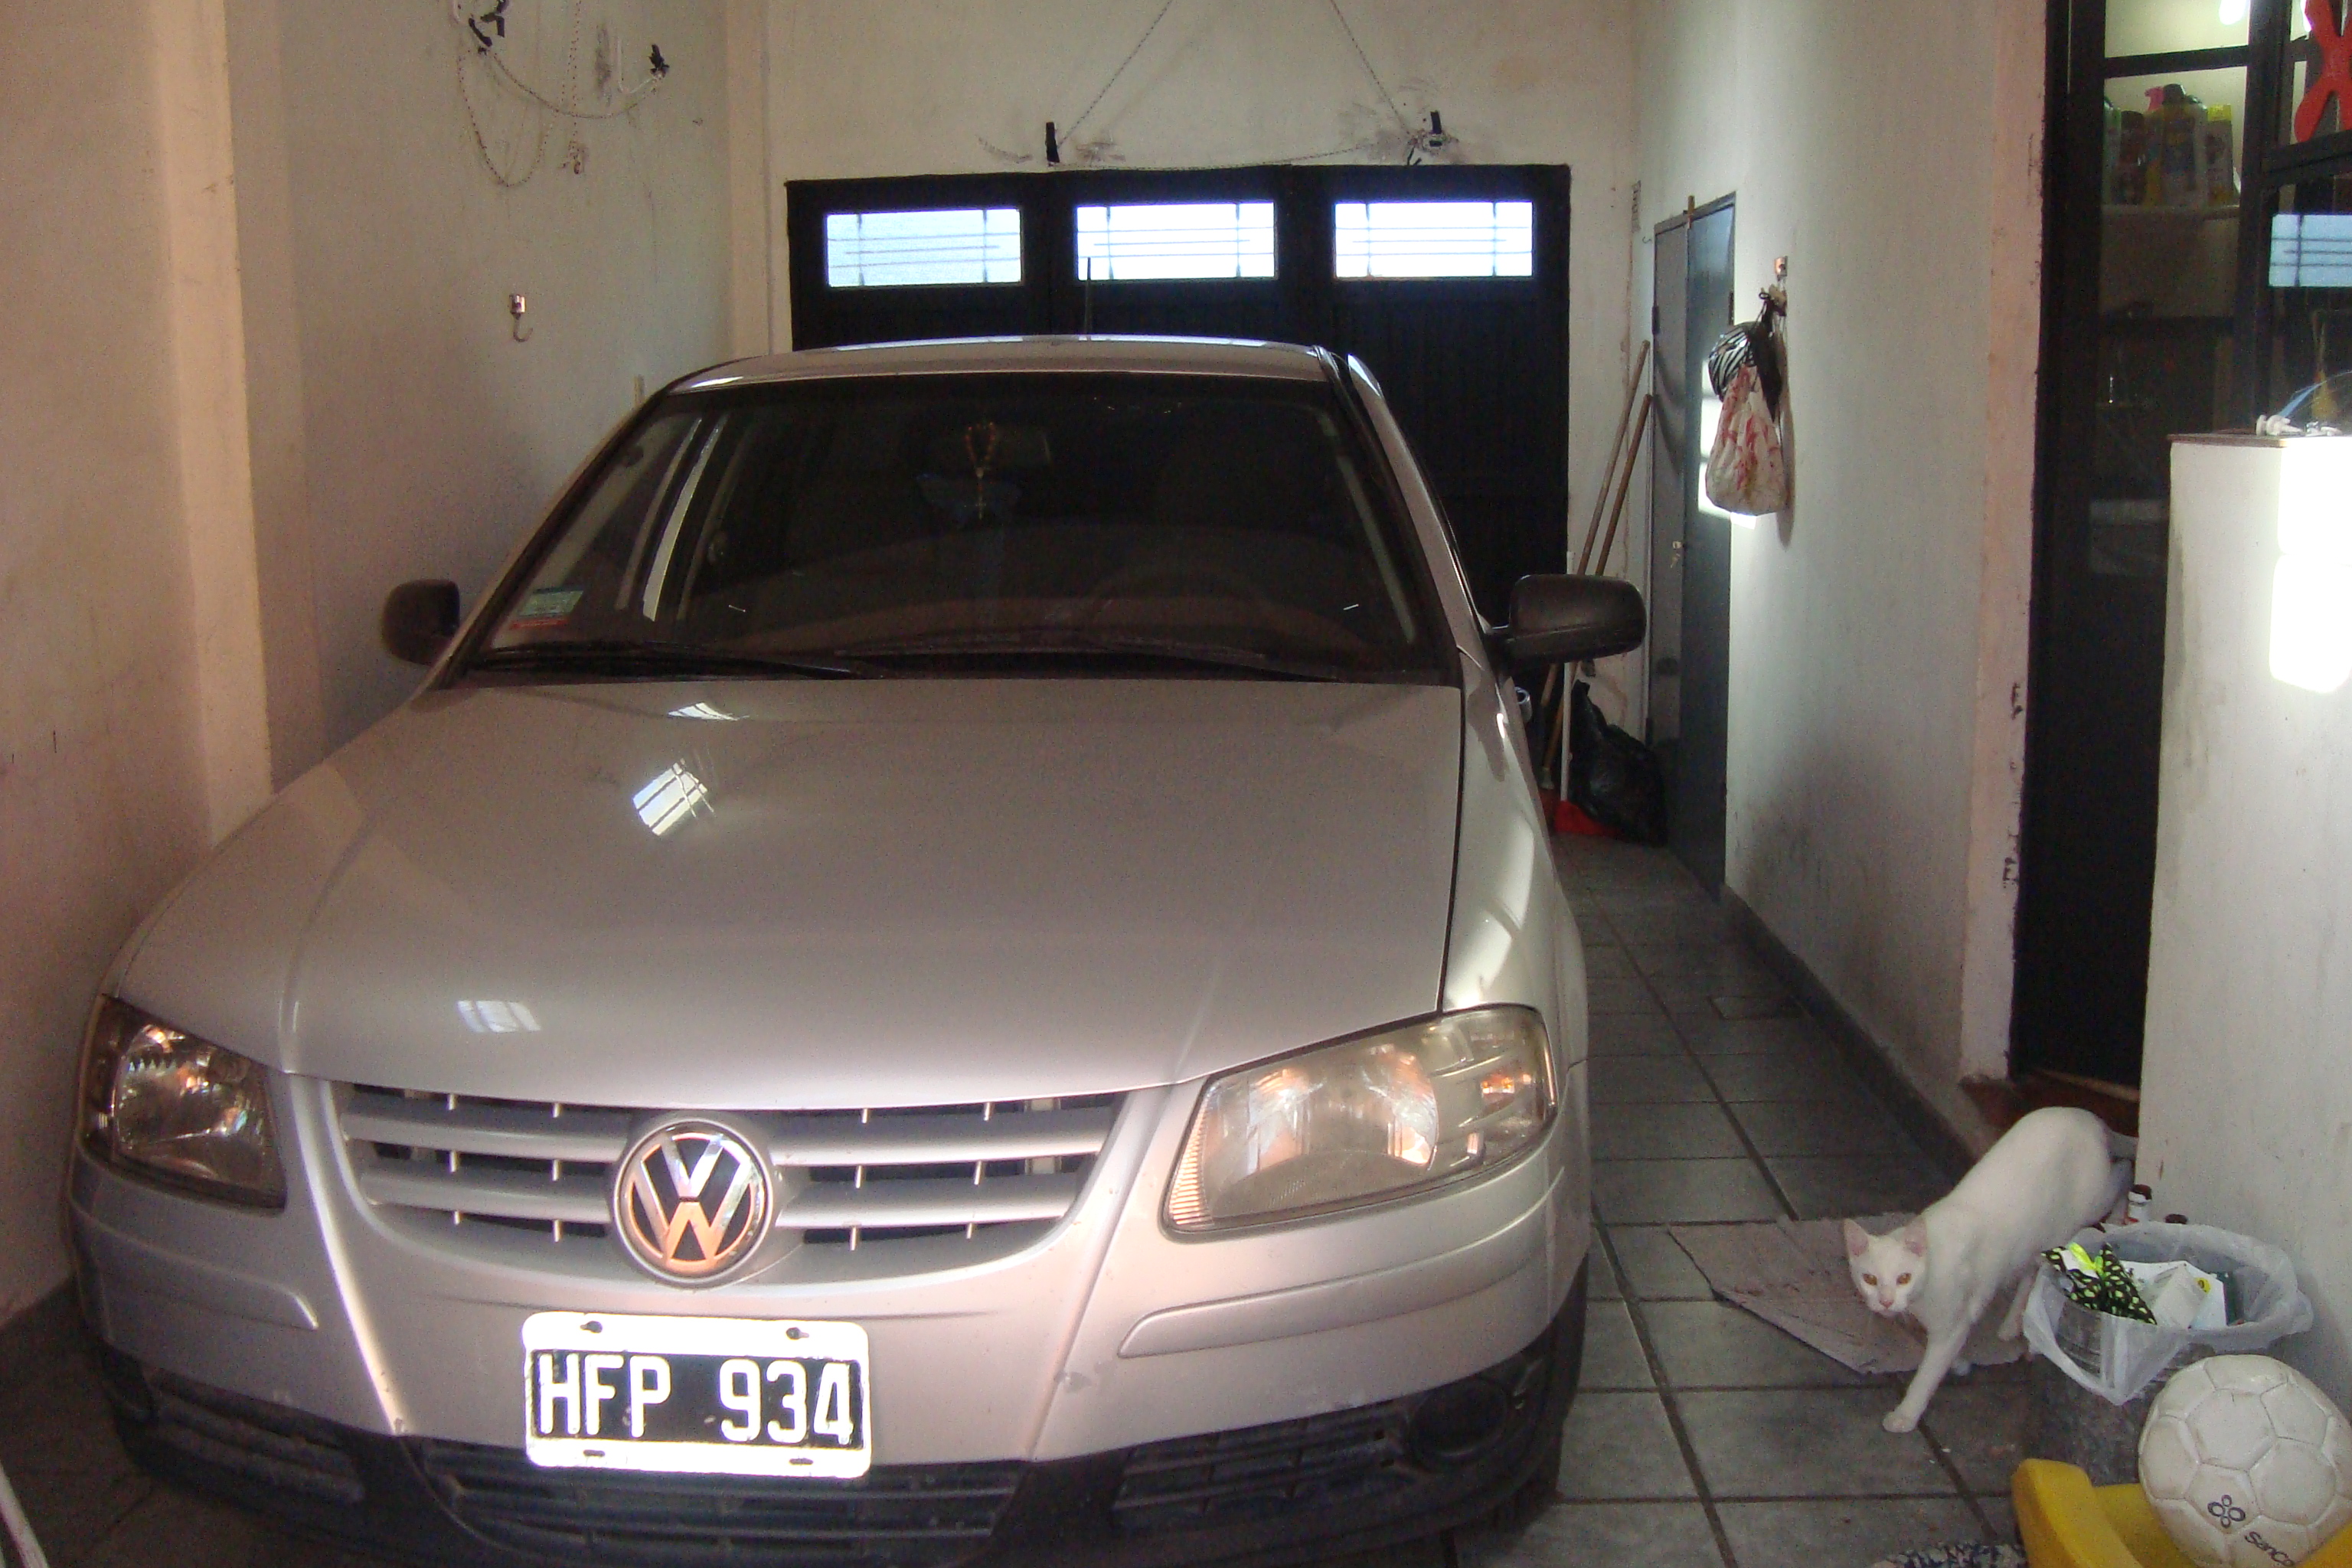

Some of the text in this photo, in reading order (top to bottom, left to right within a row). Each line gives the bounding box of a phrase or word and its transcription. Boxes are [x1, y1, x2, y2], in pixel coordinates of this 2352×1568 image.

[628, 1131, 760, 1271] VW
[538, 1354, 854, 1445] HFP 934
